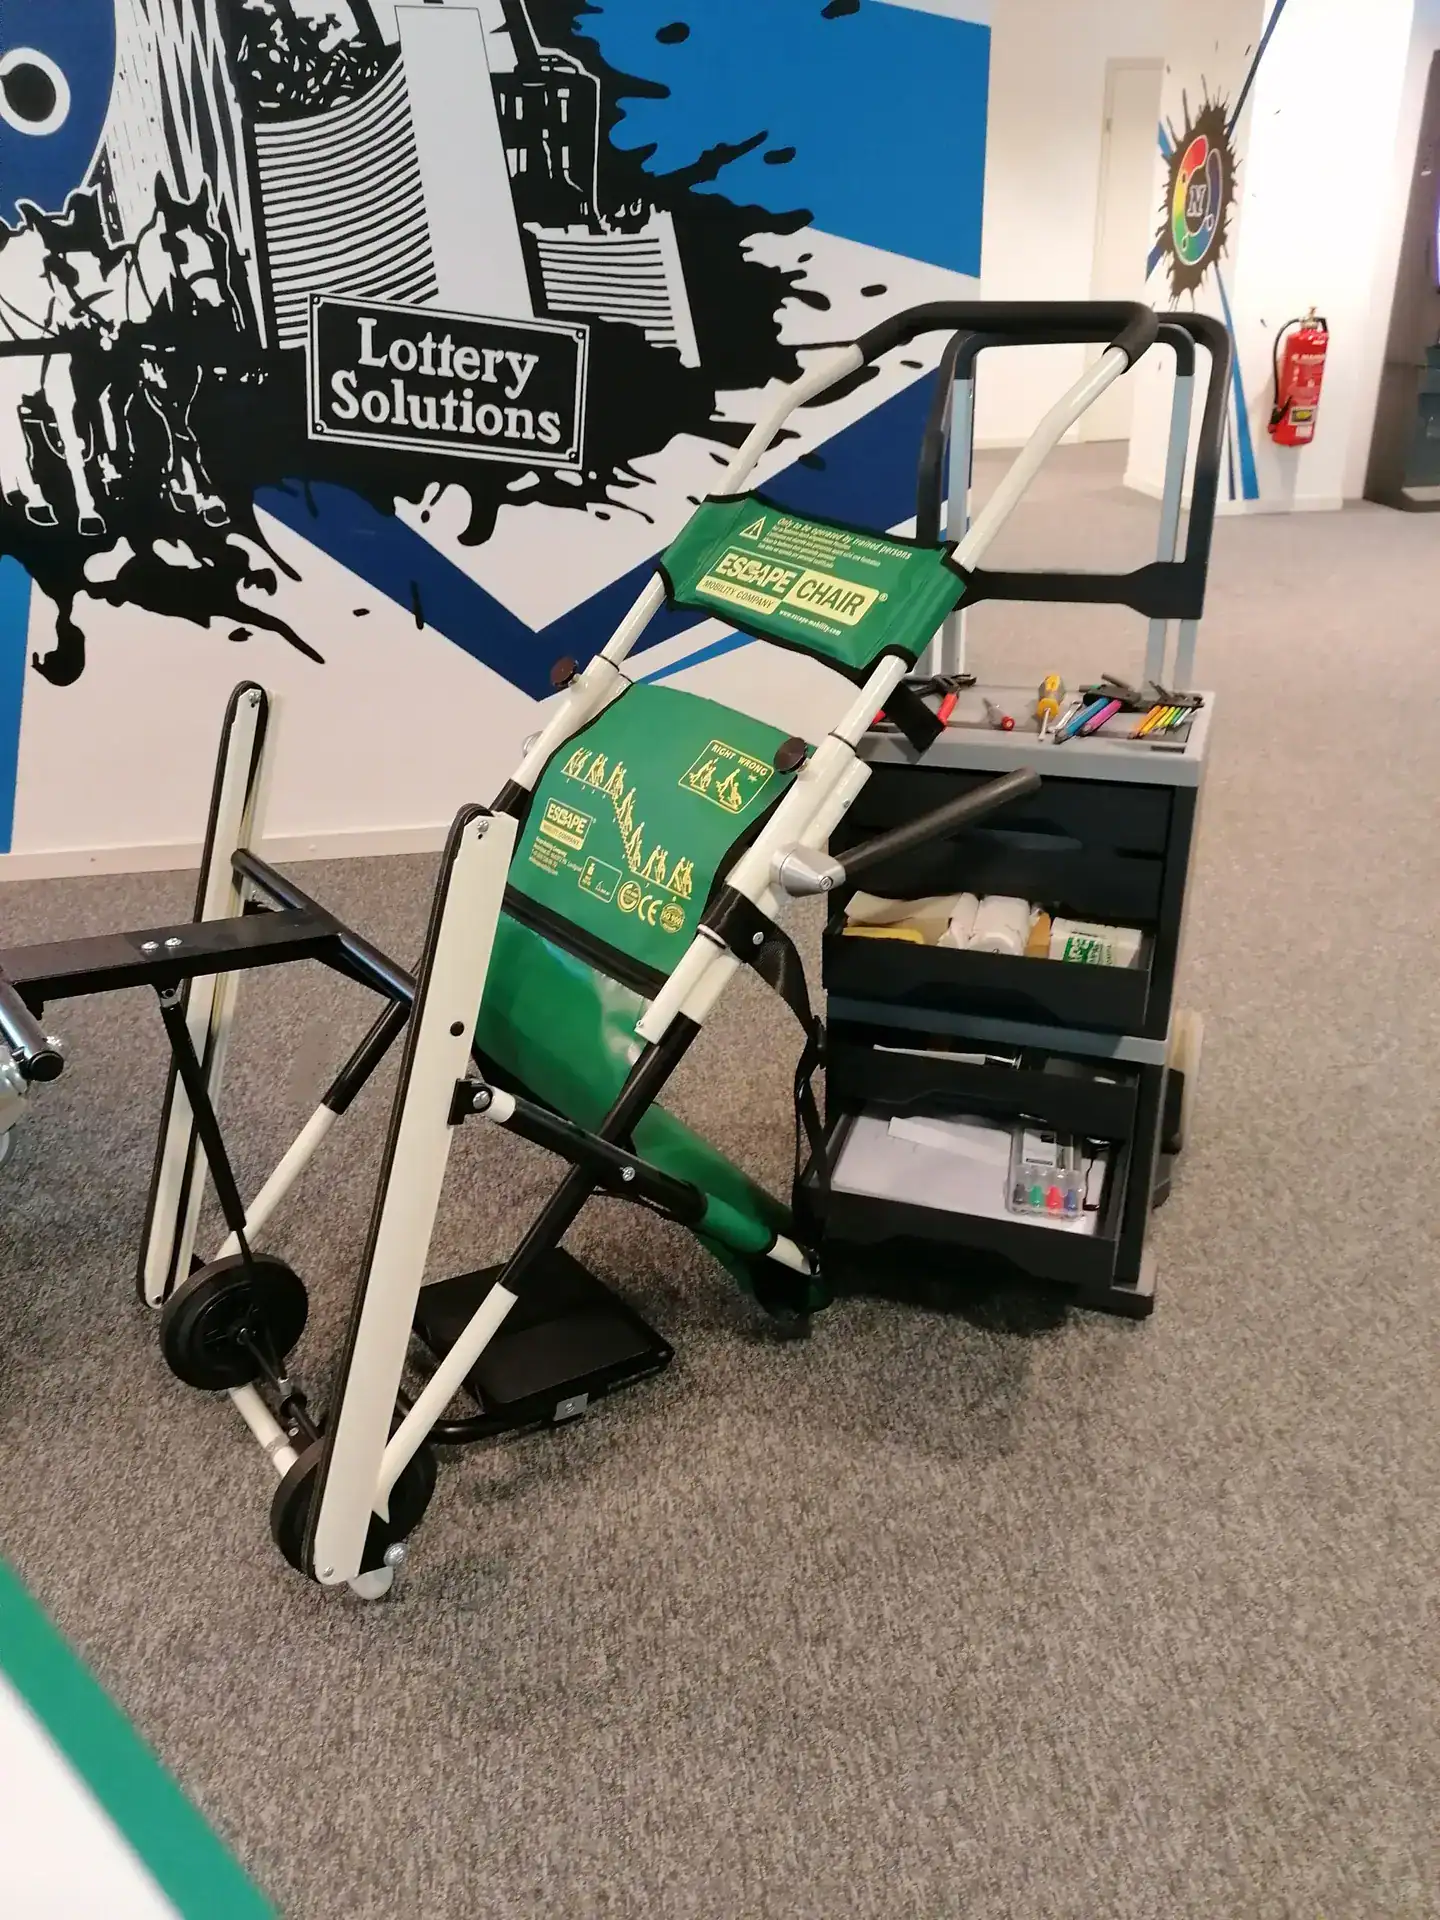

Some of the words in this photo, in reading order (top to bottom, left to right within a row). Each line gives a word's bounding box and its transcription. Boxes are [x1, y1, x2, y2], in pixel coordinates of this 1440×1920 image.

[357, 317, 539, 399] Lottery
[331, 370, 561, 445] Solutions
[842, 535, 854, 546] by
[852, 538, 883, 551] trained
[878, 544, 913, 560] persons
[704, 579, 736, 597] MOBILITY
[737, 590, 775, 610] COMPANY
[715, 552, 797, 594] ESCAPE
[796, 579, 865, 617] CHAIR
[778, 610, 842, 637] www.escape-mobility.com
[711, 743, 737, 760] RIGHT
[737, 756, 768, 776] WRONG
[546, 803, 588, 834] ESCAPE
